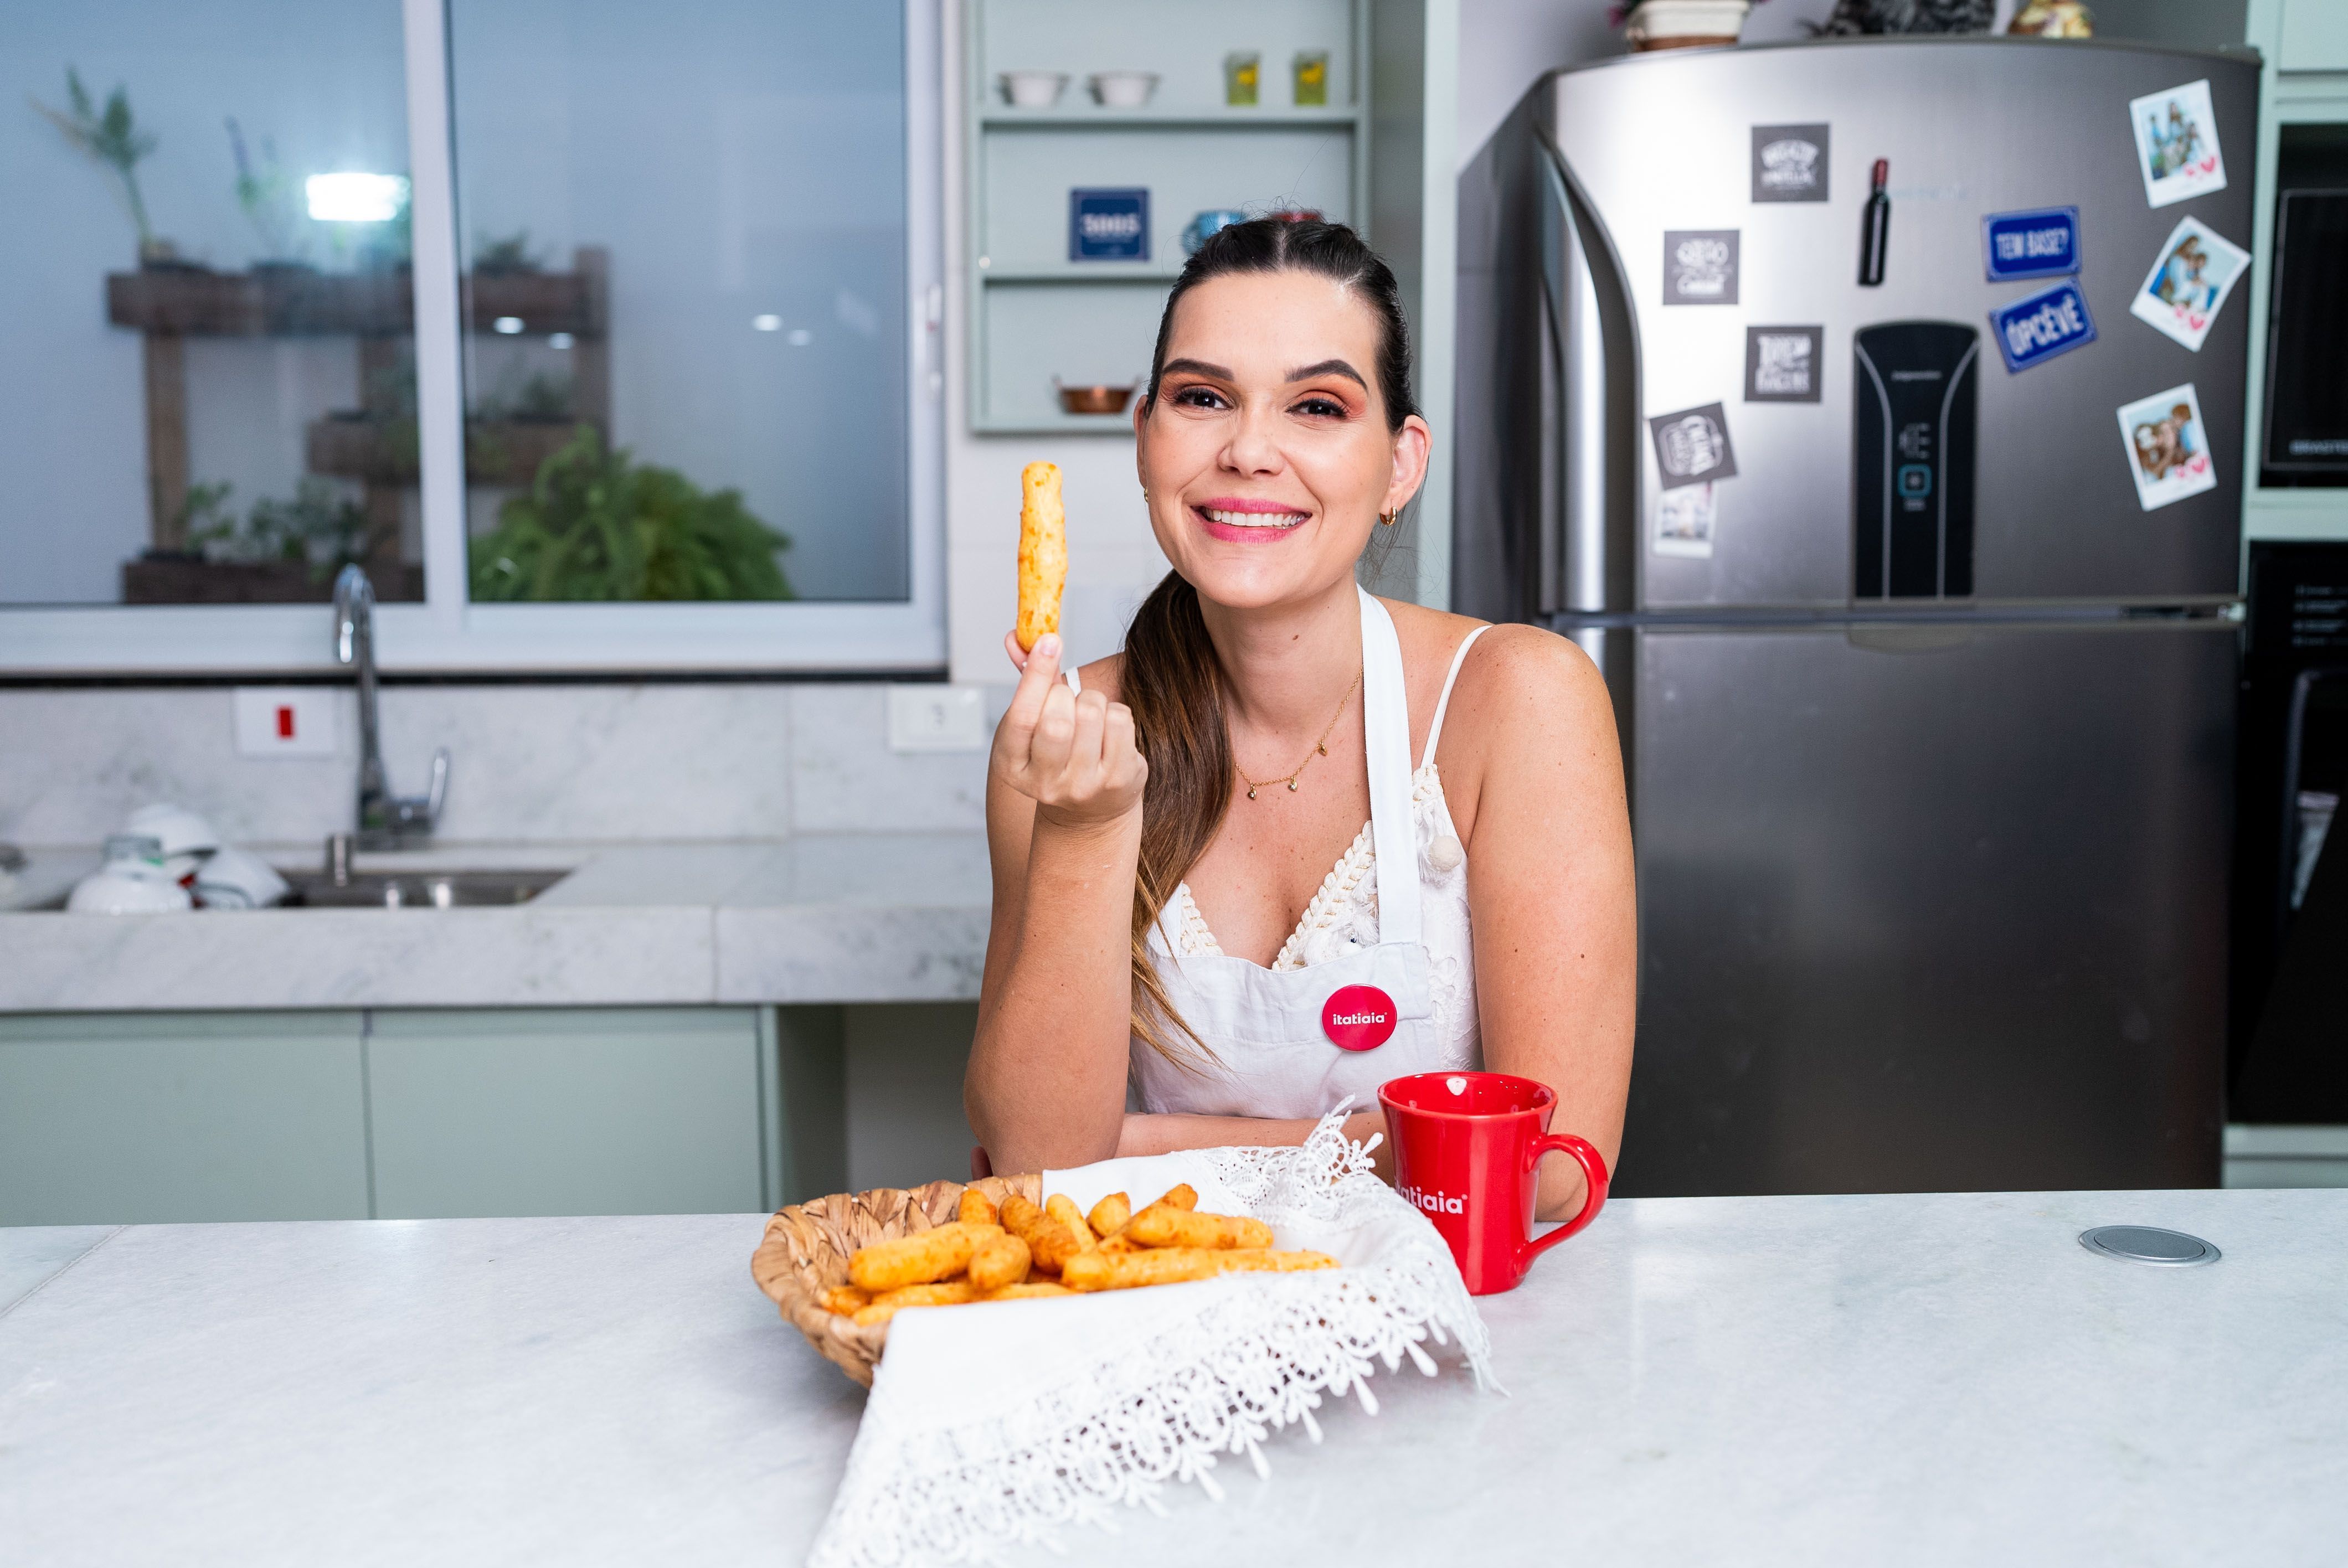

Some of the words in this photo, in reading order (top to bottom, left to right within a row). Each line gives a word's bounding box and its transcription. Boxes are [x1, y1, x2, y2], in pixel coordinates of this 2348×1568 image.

[1996, 232, 2024, 260] TEM
[2027, 227, 2069, 257] BASE?
[1333, 1012, 1385, 1025] itatiaia
